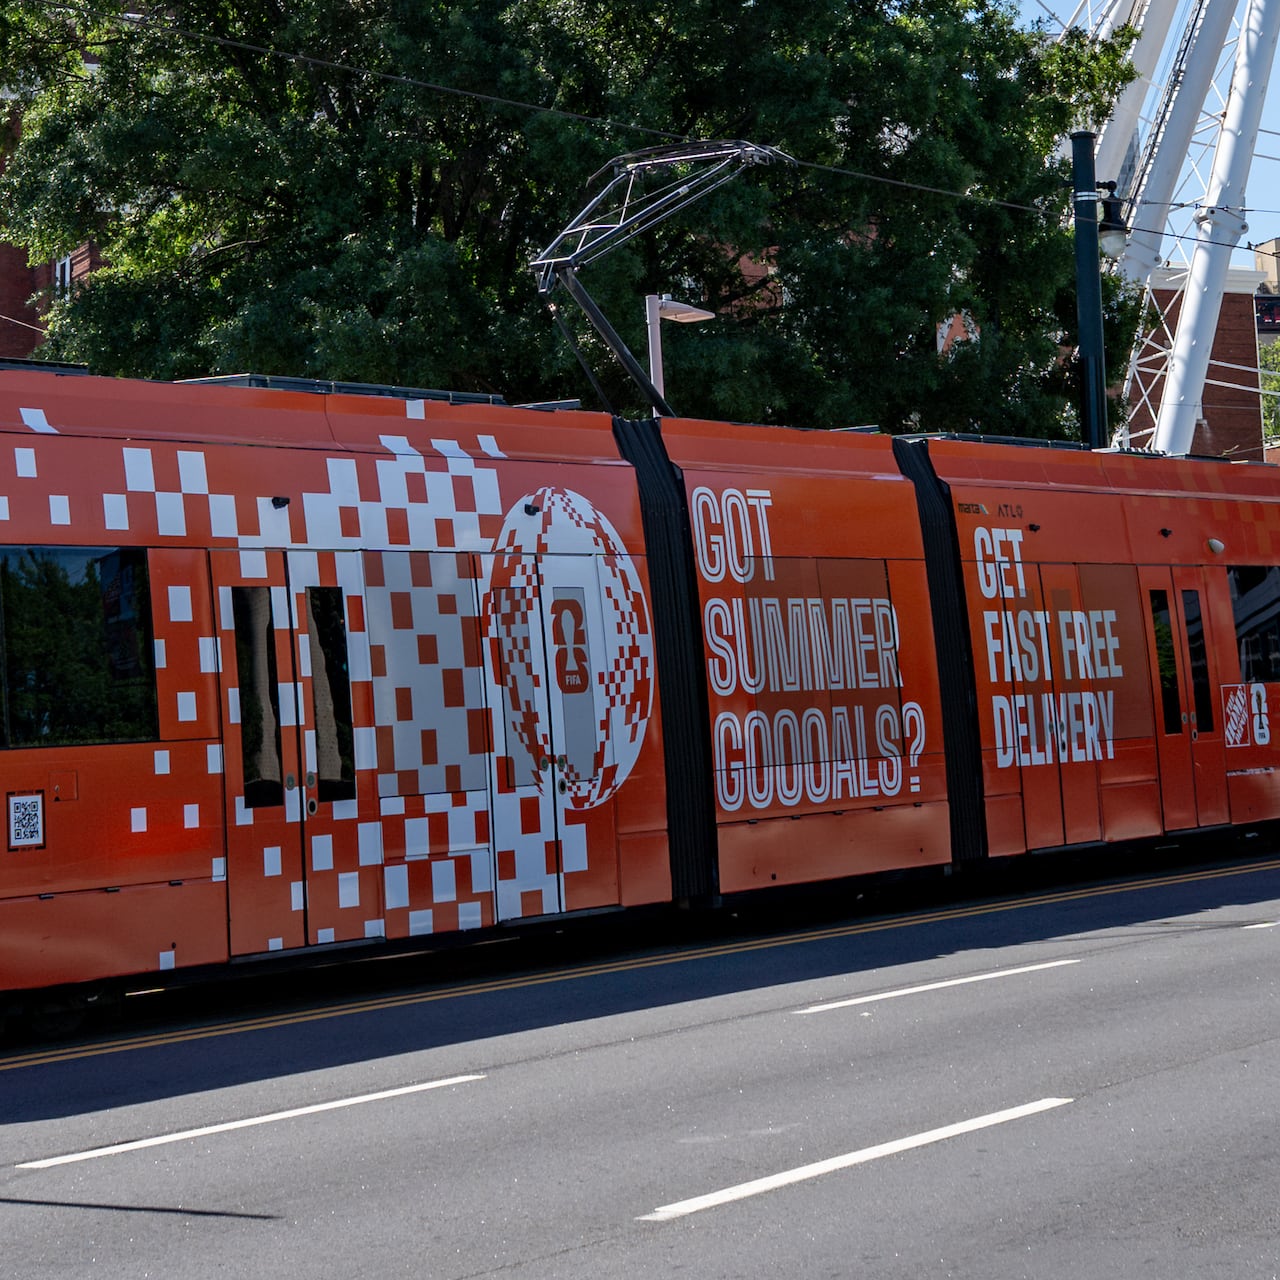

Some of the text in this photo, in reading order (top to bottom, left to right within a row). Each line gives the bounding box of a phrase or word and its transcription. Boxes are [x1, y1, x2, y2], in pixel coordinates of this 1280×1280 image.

[691, 486, 776, 584] GOT
[958, 503, 980, 514] marta
[973, 526, 1027, 600] GET
[565, 674, 581, 686] FIFA
[703, 596, 903, 697] SUMMER
[983, 609, 1123, 683] FAST FREE
[713, 701, 926, 812] GOOOALS?
[991, 690, 1115, 769] DELIVERY
